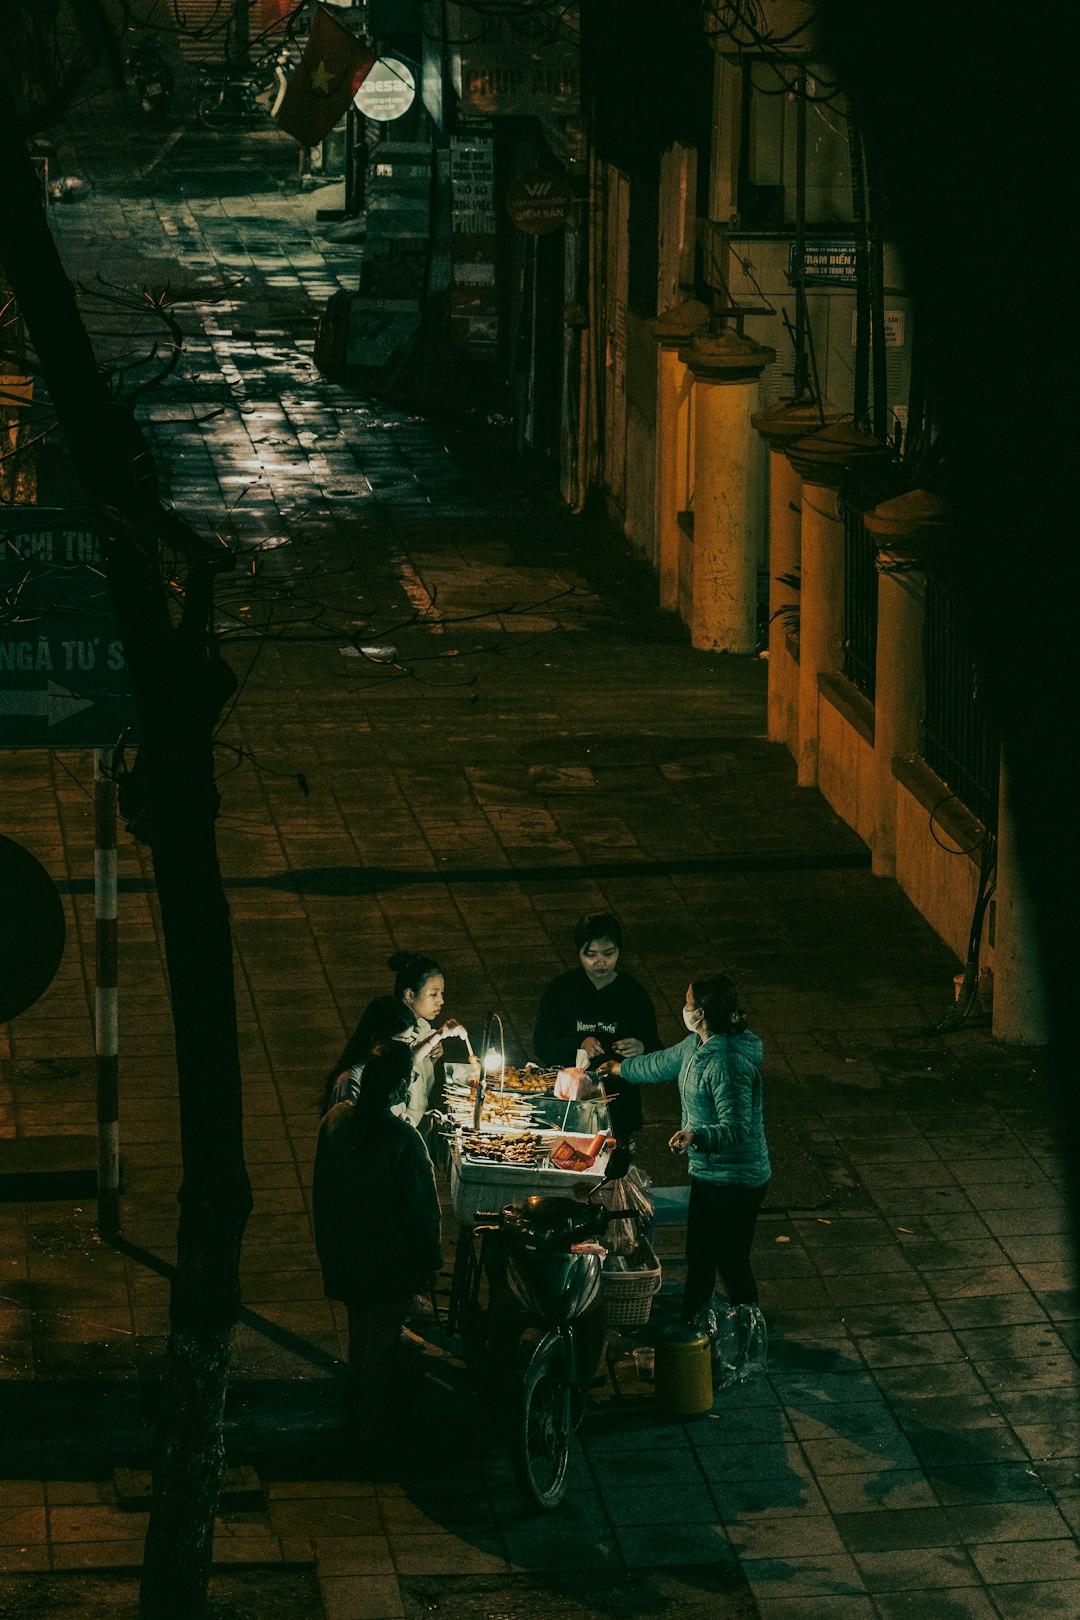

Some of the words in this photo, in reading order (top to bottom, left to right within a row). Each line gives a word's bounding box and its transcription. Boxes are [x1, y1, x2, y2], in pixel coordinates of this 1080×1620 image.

[829, 253, 851, 265] BIẾN
[0, 635, 54, 671] NGÃ
[61, 637, 100, 671] TƯ
[107, 640, 129, 671] S
[577, 1021, 596, 1032] Never
